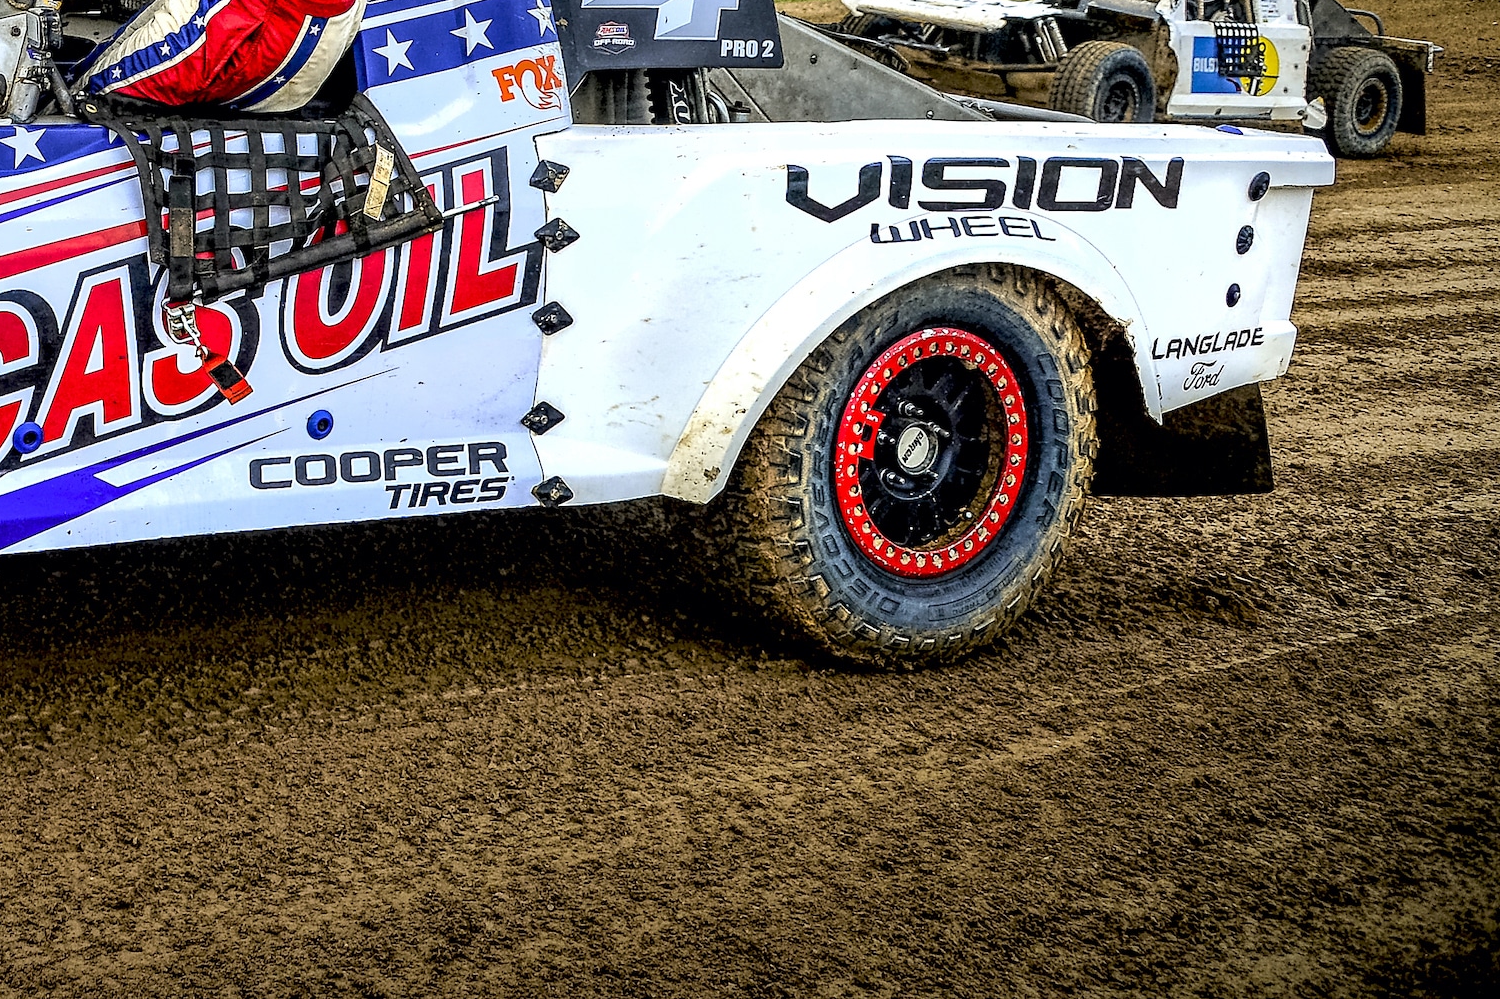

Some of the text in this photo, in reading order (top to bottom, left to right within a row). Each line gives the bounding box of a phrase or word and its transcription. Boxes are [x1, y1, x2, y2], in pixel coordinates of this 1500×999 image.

[720, 38, 775, 58] PRO 2
[491, 54, 563, 110] FOX
[786, 155, 1185, 223] VISION
[870, 216, 1057, 243] WHEEL
[284, 162, 524, 372] OIL
[1151, 327, 1265, 360] LANGLADE
[1183, 360, 1225, 391] Ford
[249, 441, 509, 490] COOPER
[385, 476, 510, 510] TIRES
